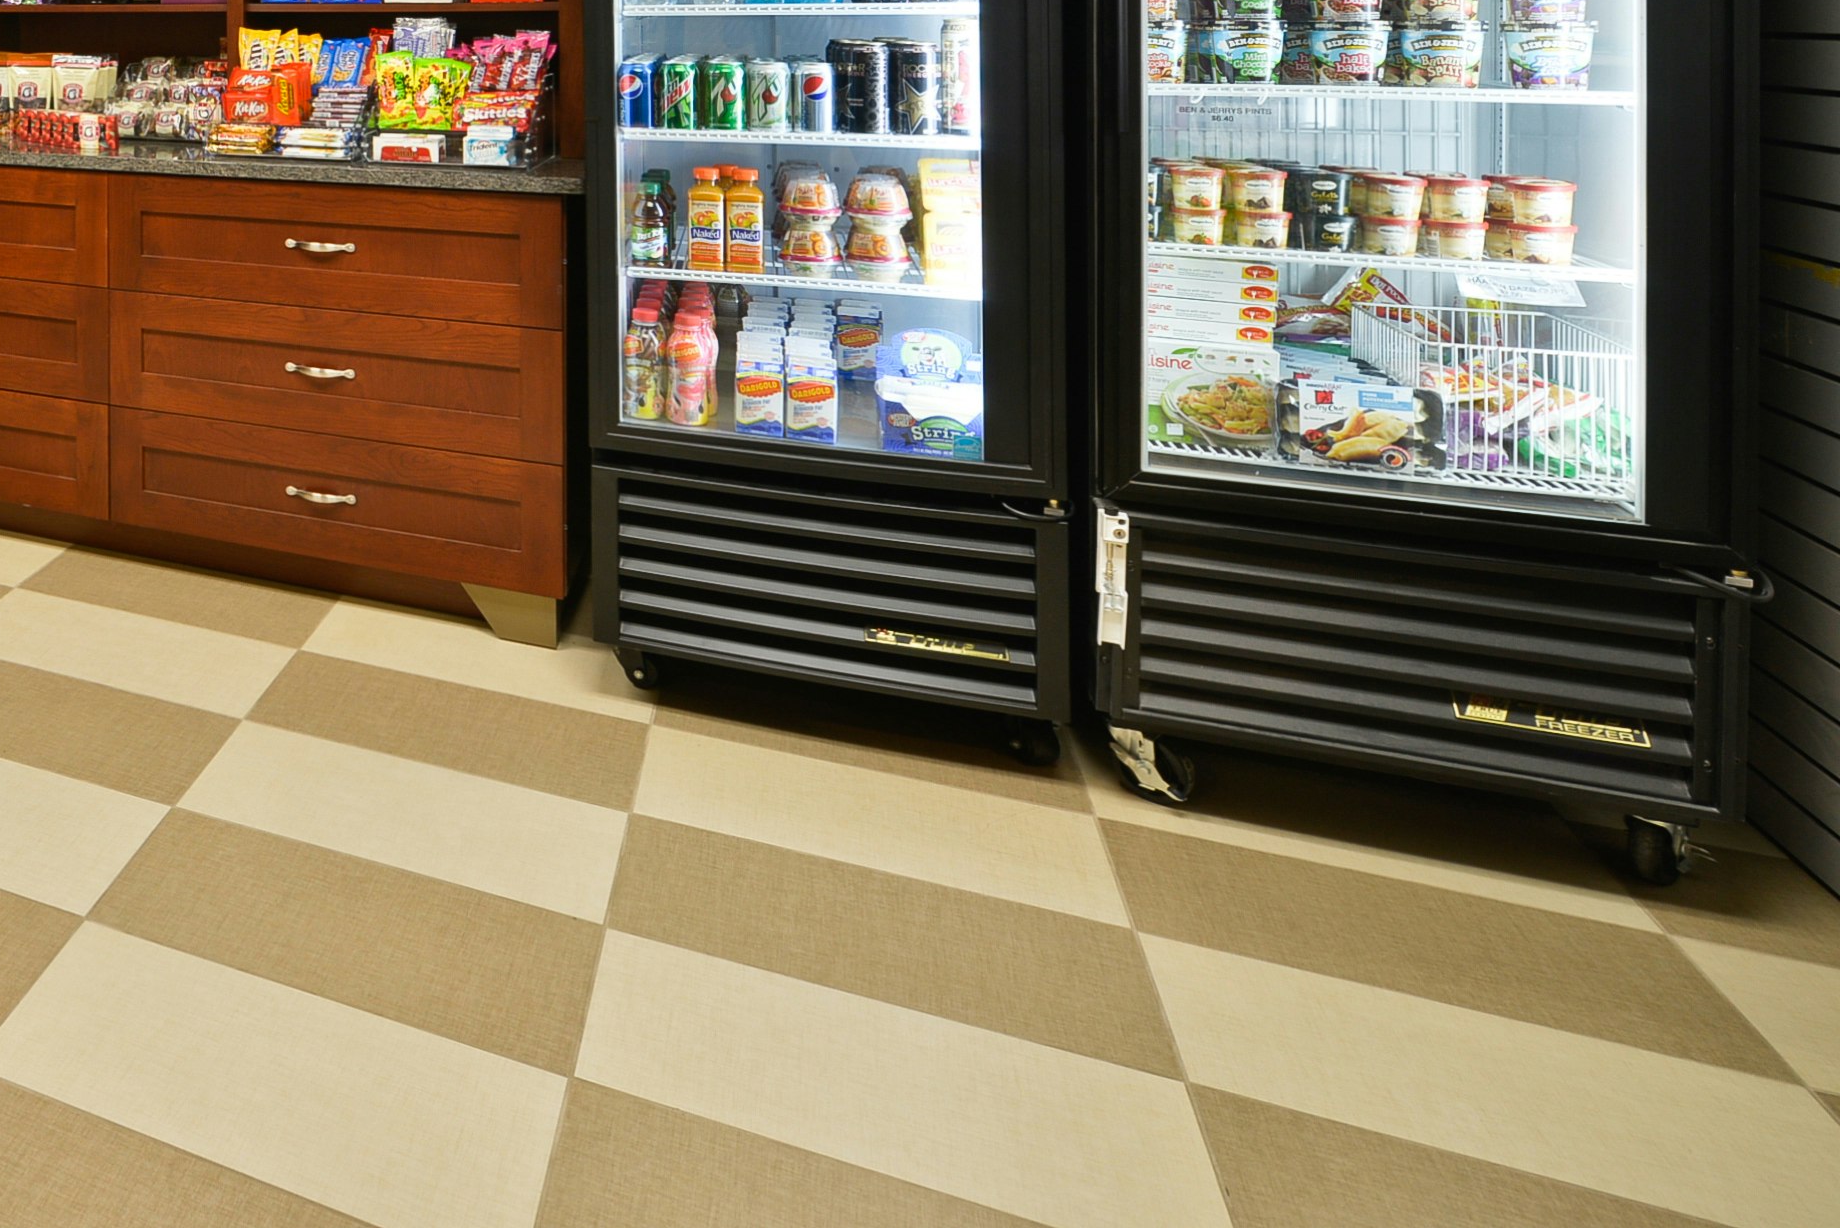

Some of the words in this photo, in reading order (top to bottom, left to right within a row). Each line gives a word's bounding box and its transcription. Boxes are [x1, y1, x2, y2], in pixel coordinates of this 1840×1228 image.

[1244, 52, 1269, 61] Mint
[1341, 53, 1370, 63] half
[1421, 55, 1468, 66] Banana
[1428, 65, 1462, 77] SPLIT
[392, 71, 407, 101] SOUR
[463, 105, 527, 122] Skittles
[1178, 106, 1197, 114] BEN
[469, 140, 499, 152] Trident
[1321, 232, 1345, 240] Gelat
[1150, 354, 1193, 370] isine
[907, 363, 956, 379] String
[740, 380, 778, 392] DARIGOLD
[792, 386, 831, 398] DARIGOLD
[1303, 402, 1327, 413] Carry
[1535, 718, 1636, 742] FREEZER
